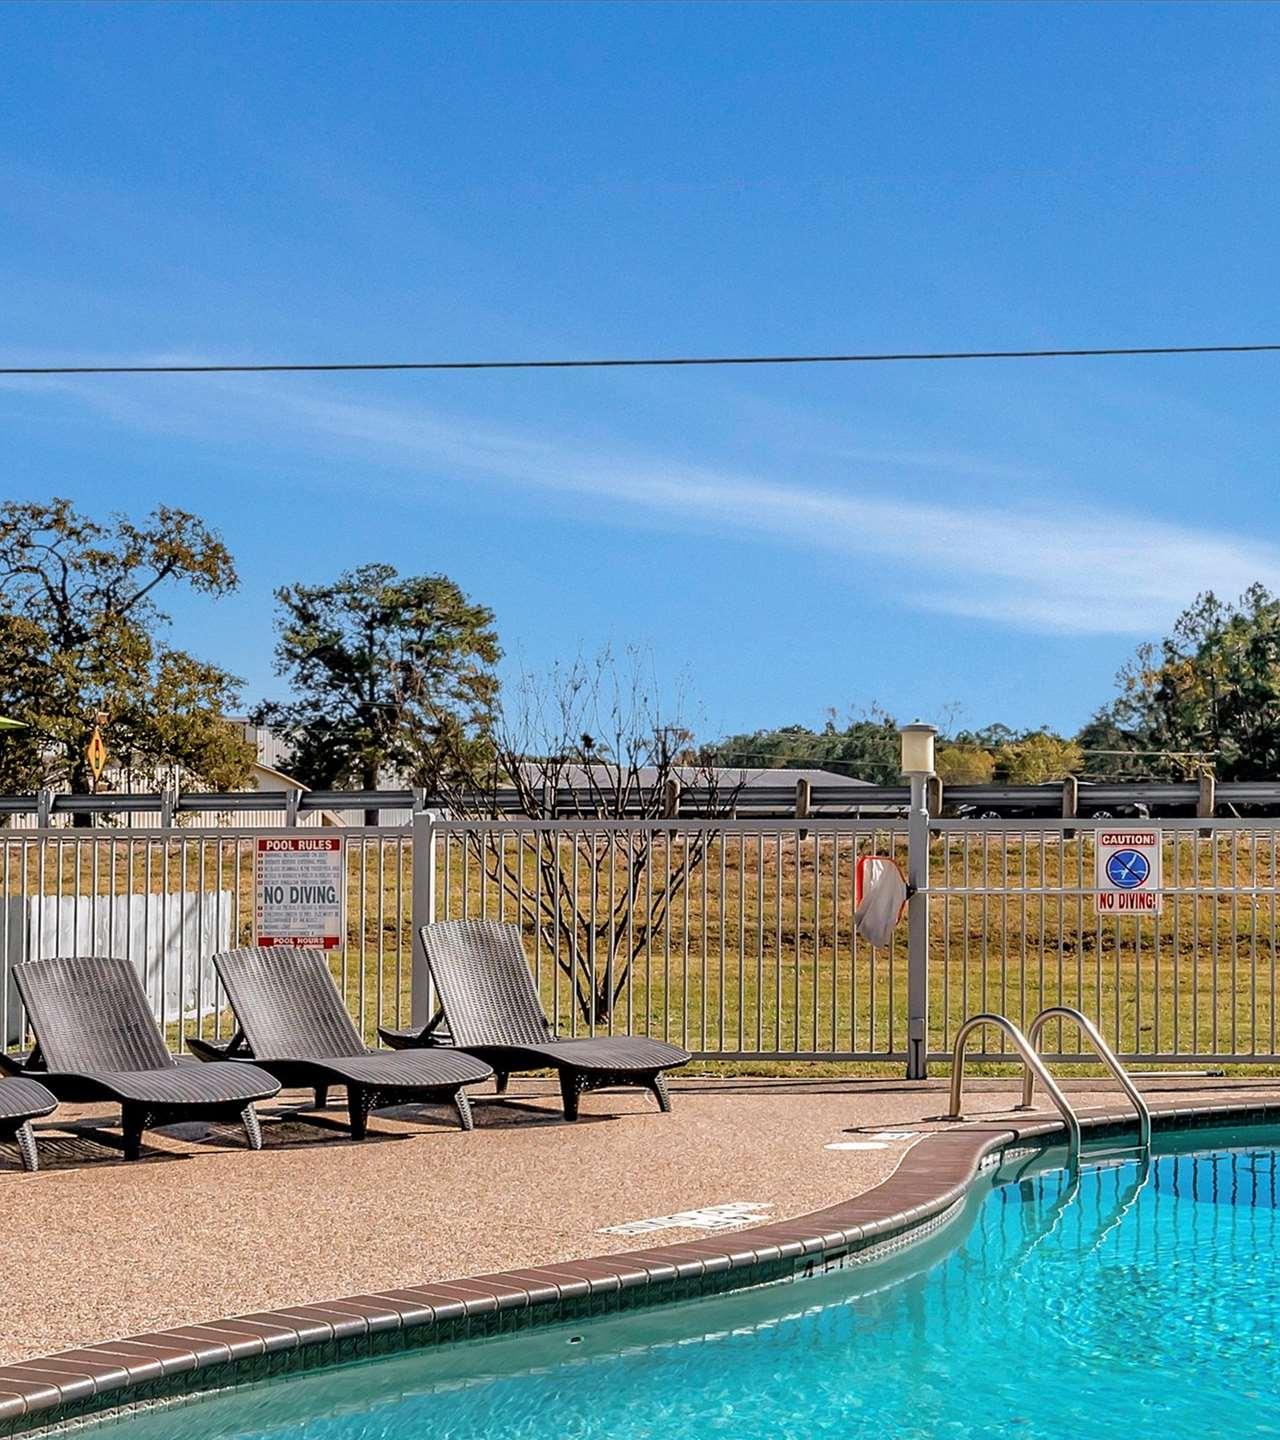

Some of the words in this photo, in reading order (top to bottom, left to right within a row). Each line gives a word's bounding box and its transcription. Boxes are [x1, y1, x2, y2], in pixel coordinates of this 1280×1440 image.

[266, 840, 295, 850] POOL
[298, 840, 332, 850] RULES
[1102, 834, 1155, 845] CAUTION!
[264, 886, 284, 904] NO
[290, 886, 339, 904] DIVING.
[1100, 893, 1114, 909] NO
[1119, 893, 1156, 909] DIVING!
